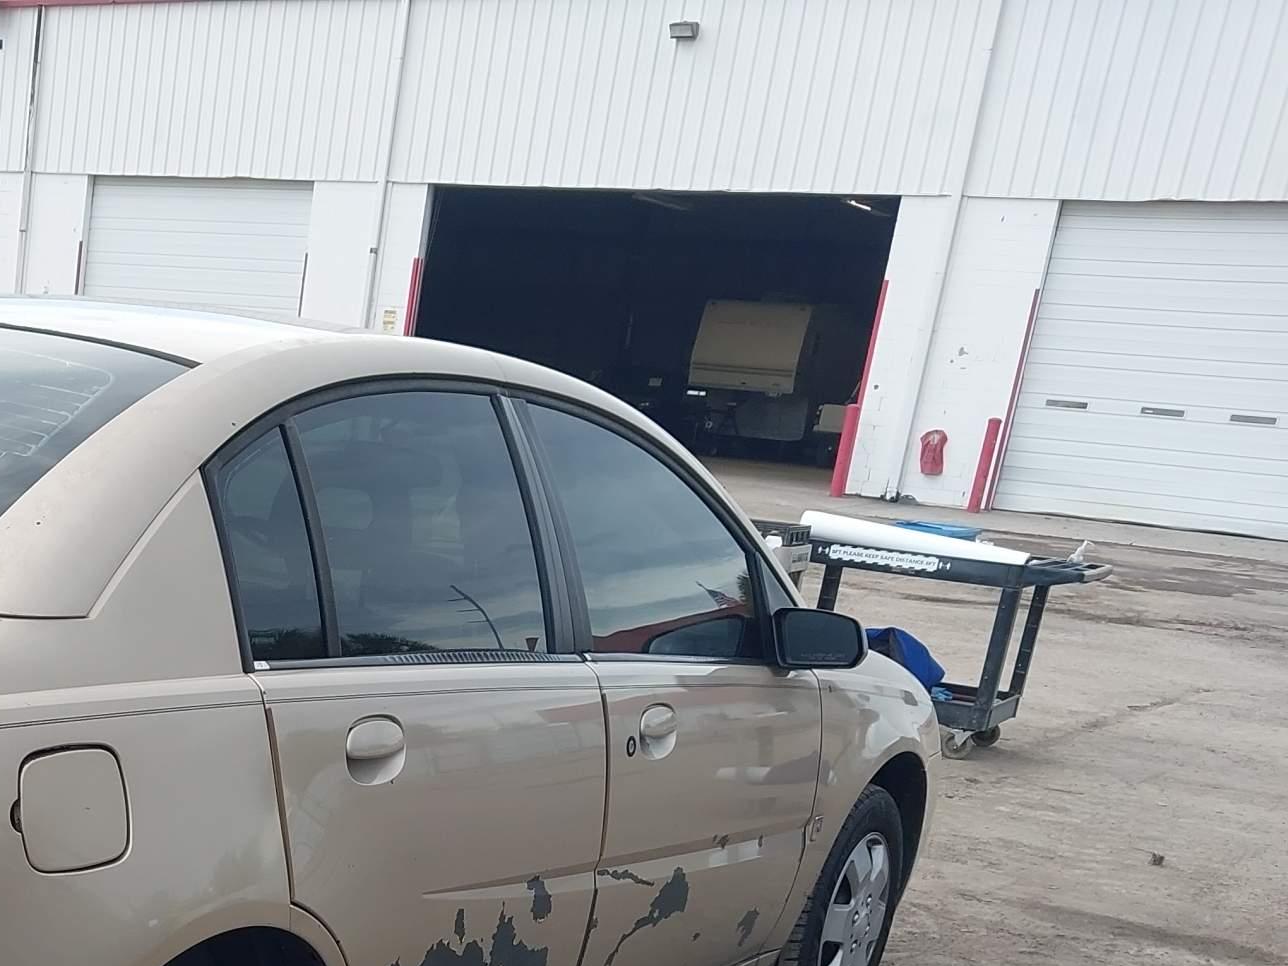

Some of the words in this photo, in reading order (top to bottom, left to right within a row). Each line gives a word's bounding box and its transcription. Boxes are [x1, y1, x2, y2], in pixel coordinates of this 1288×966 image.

[843, 550, 864, 559] PLEASE
[864, 552, 879, 560] KEEP
[895, 556, 924, 566] DISTANCE
